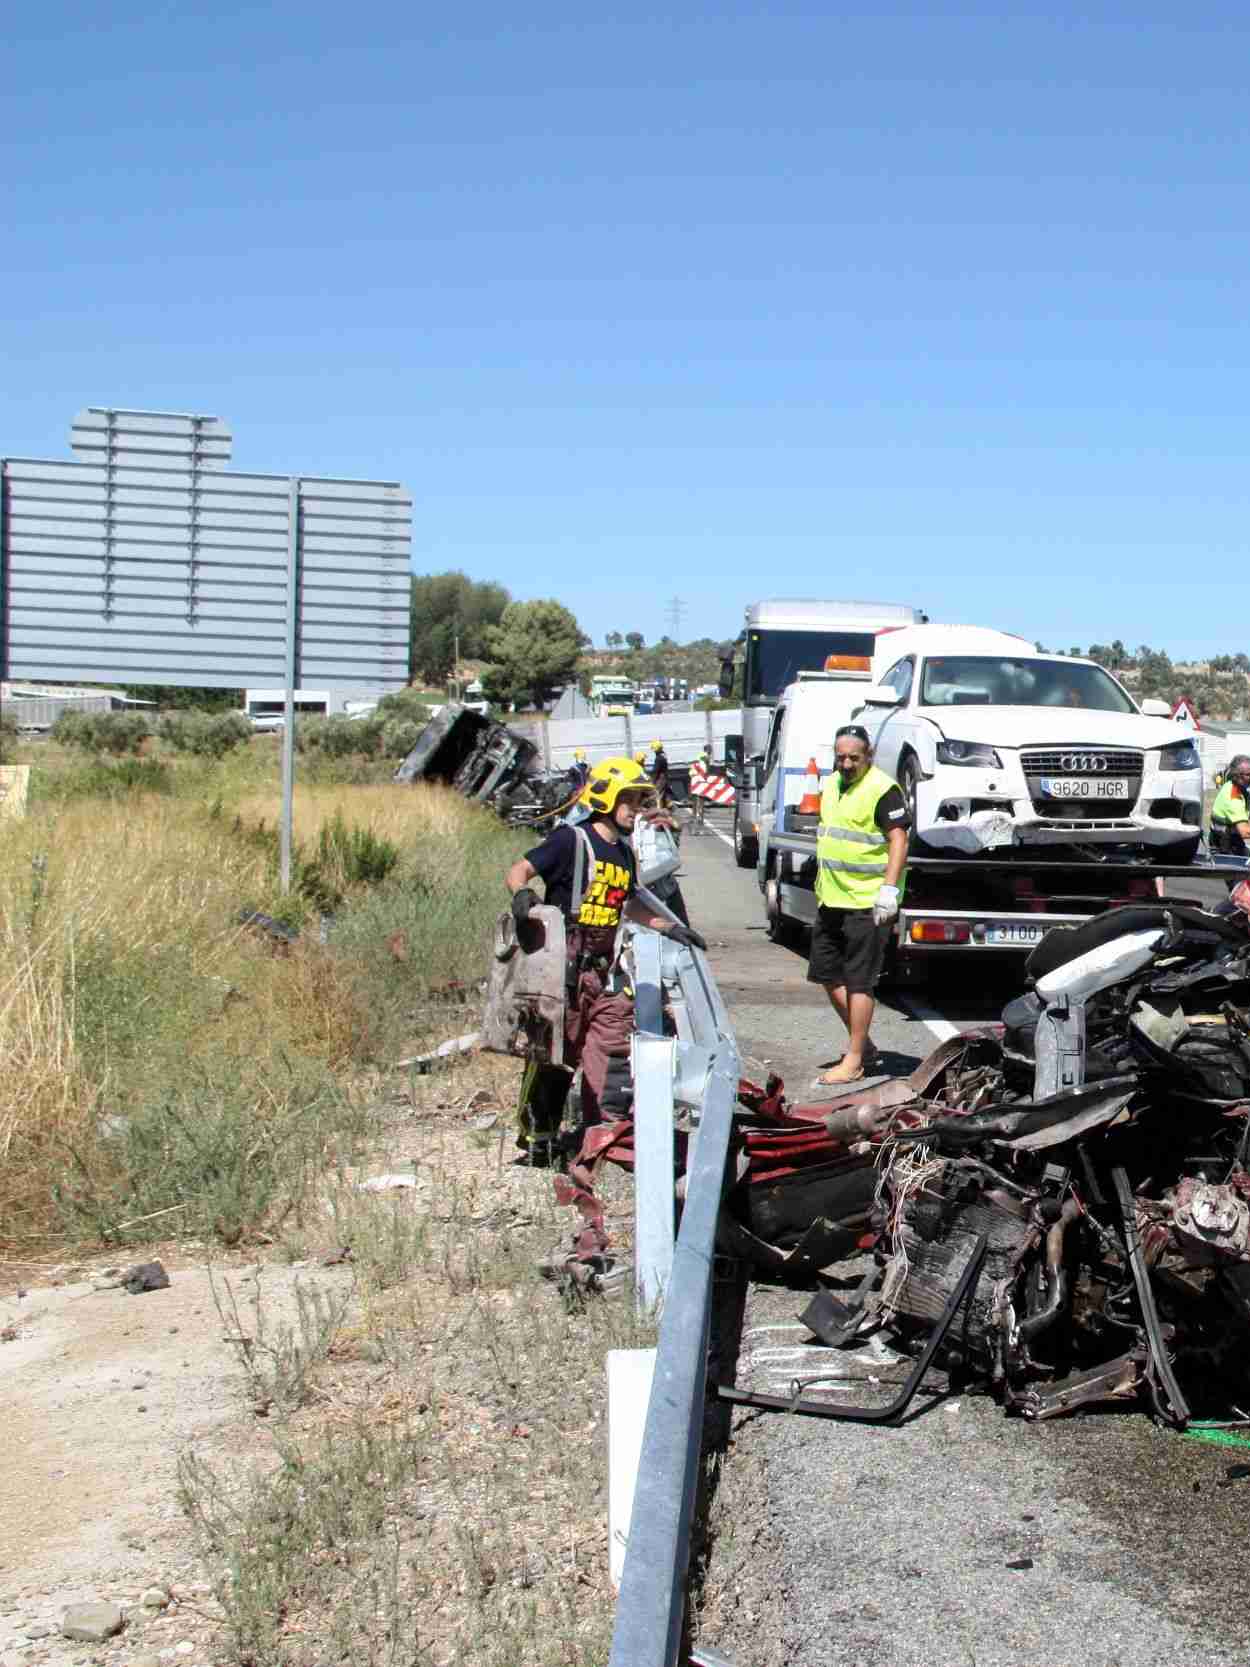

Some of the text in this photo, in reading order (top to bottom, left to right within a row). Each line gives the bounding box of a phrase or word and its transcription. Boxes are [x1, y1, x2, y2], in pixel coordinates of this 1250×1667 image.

[1053, 782, 1124, 796] 9620 HGR
[1000, 925, 1036, 940] 3100
